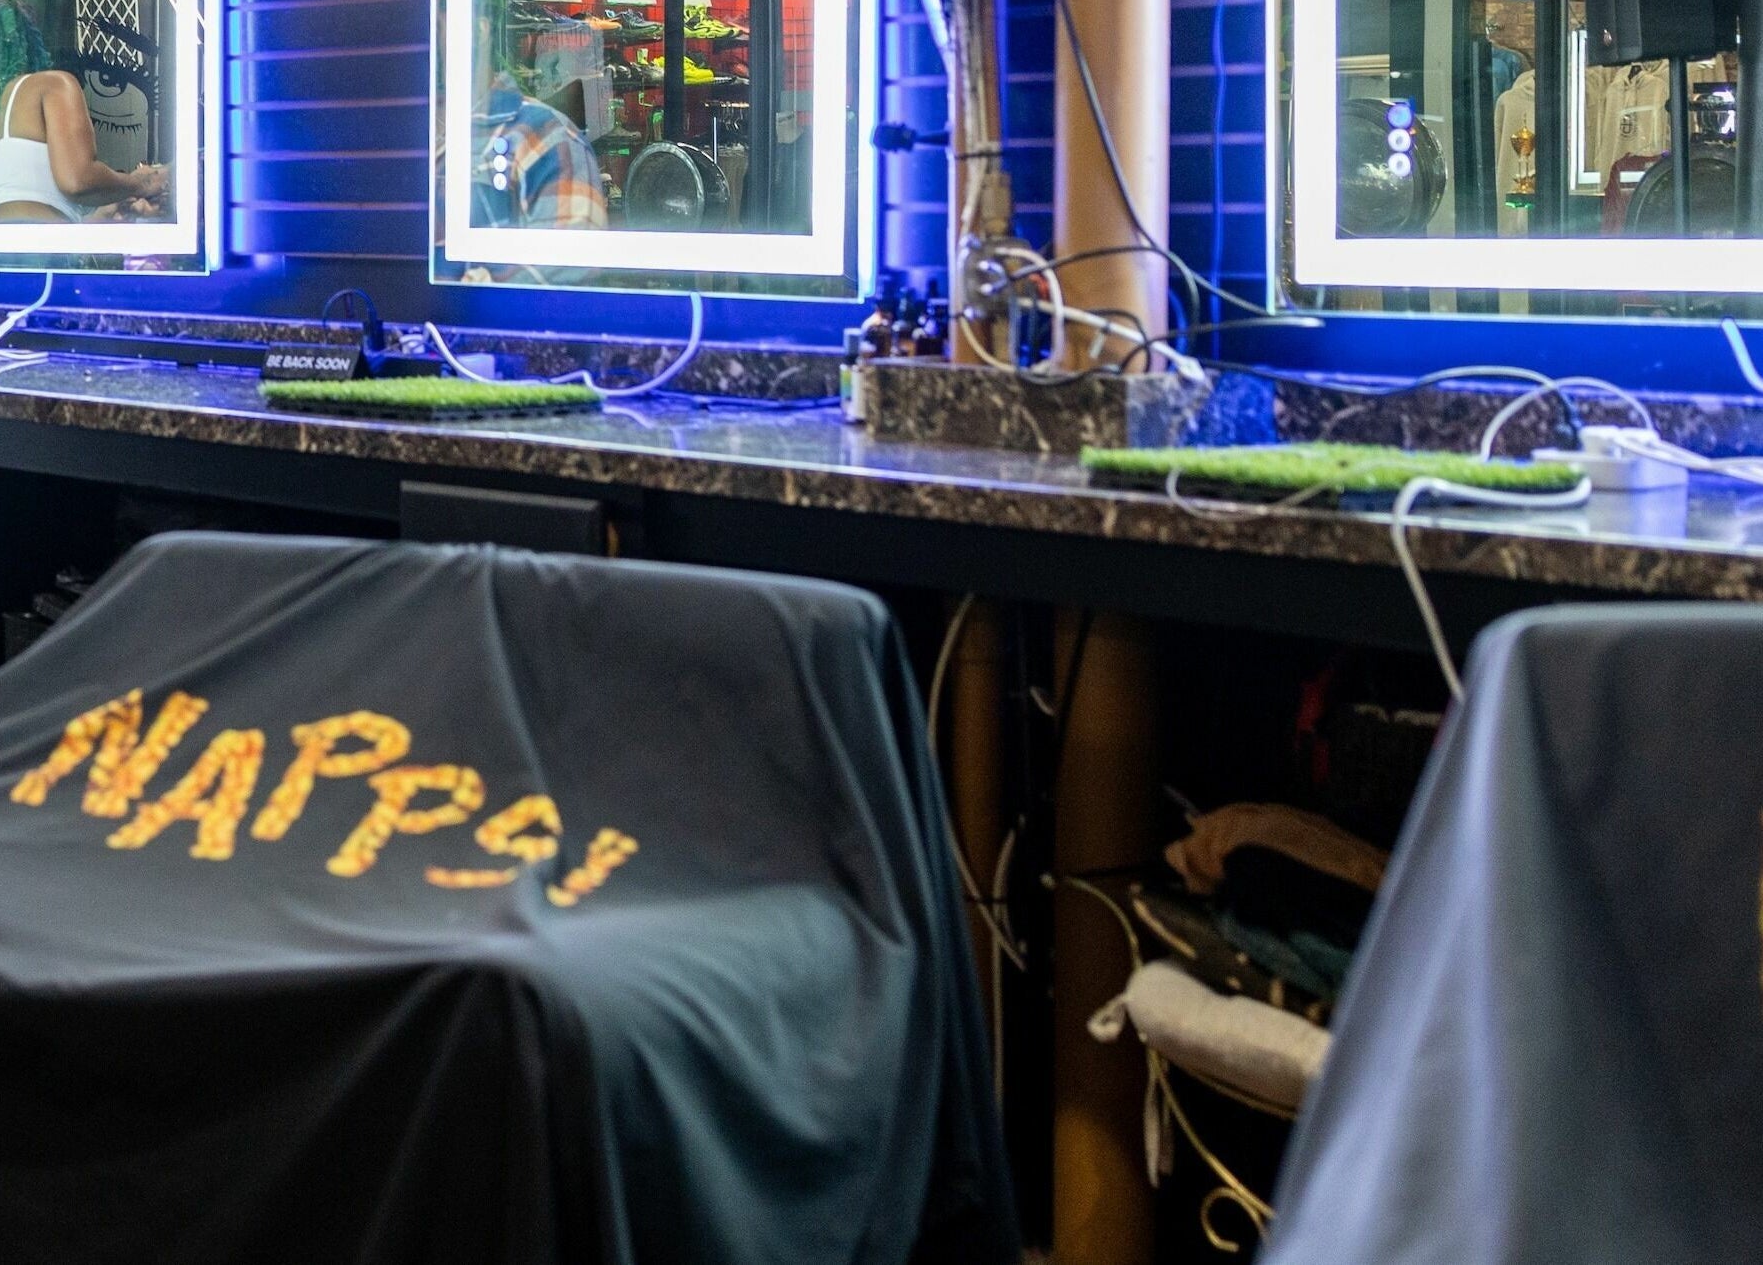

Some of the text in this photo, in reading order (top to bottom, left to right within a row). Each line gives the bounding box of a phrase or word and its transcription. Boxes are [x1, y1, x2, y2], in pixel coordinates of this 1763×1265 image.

[266, 354, 351, 371] BE BACK SOON
